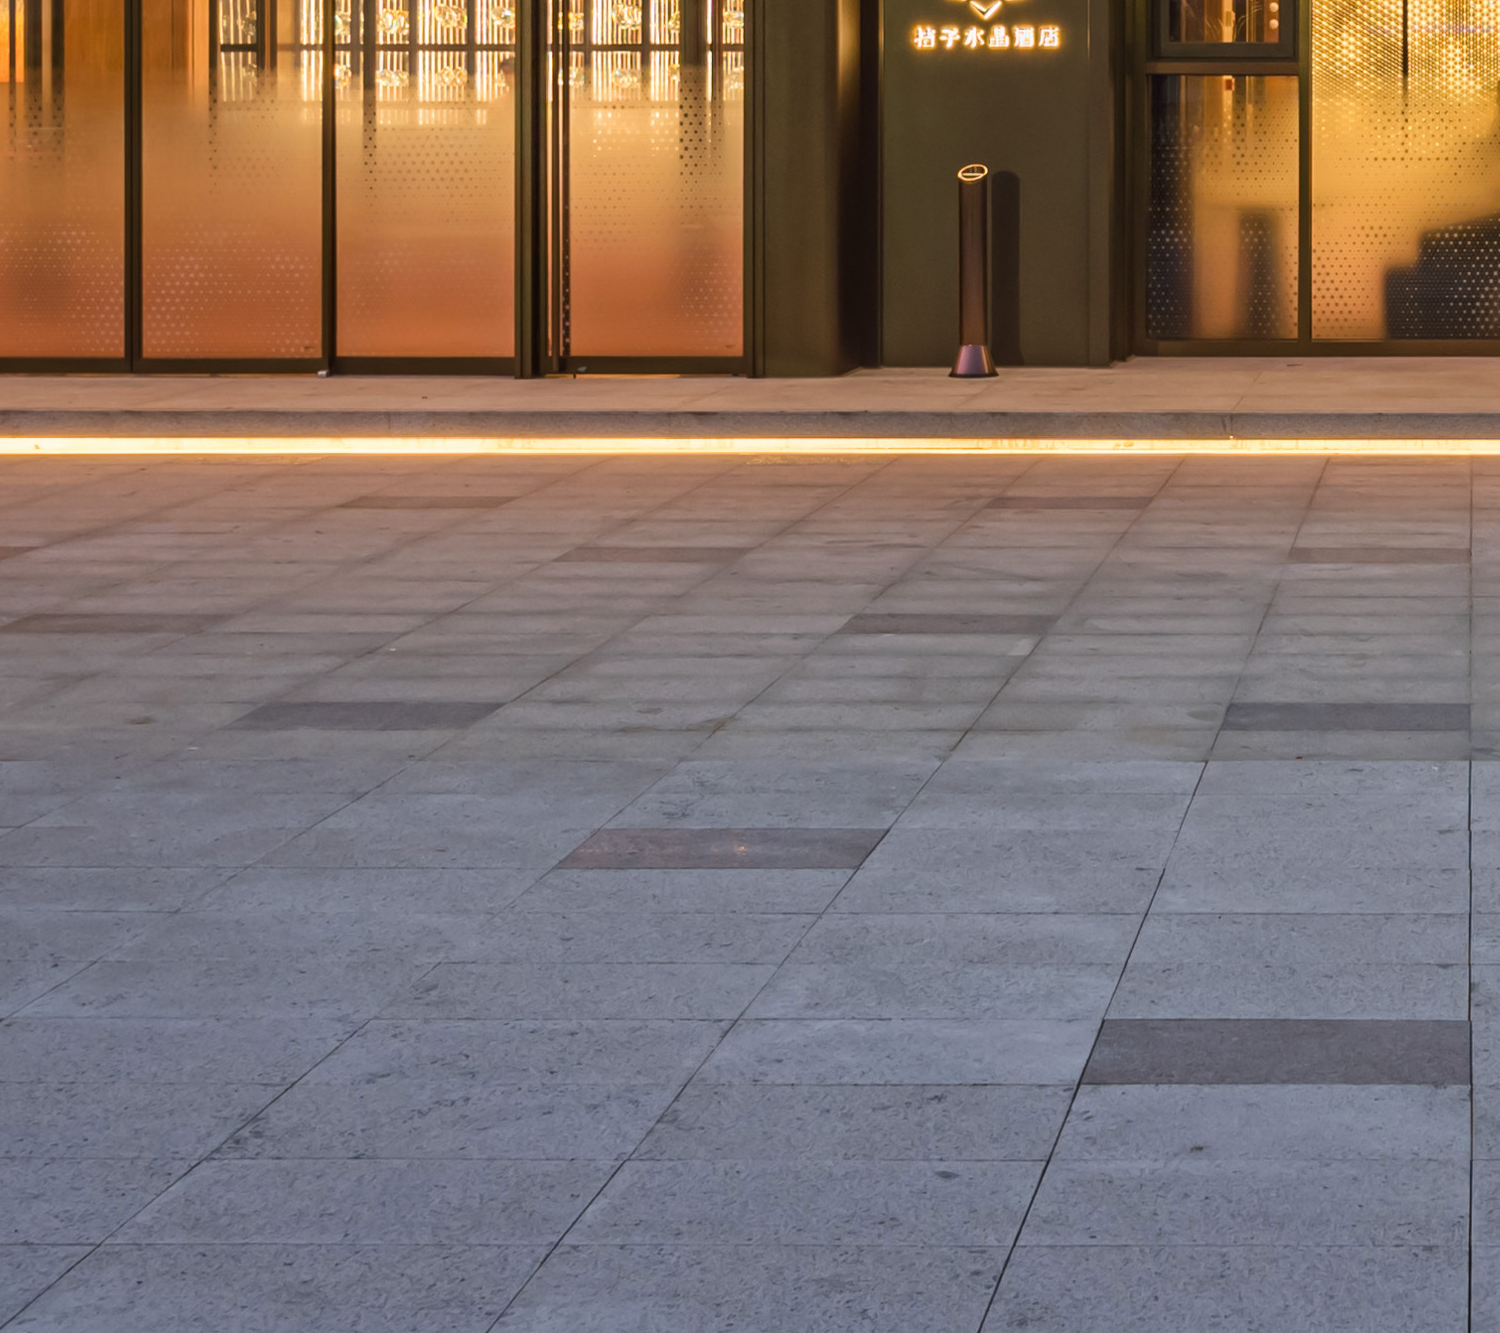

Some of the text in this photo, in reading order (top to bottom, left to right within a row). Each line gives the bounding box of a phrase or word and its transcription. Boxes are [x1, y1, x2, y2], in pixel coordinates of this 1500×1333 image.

[912, 24, 1061, 50] 桔子水晶酒店
